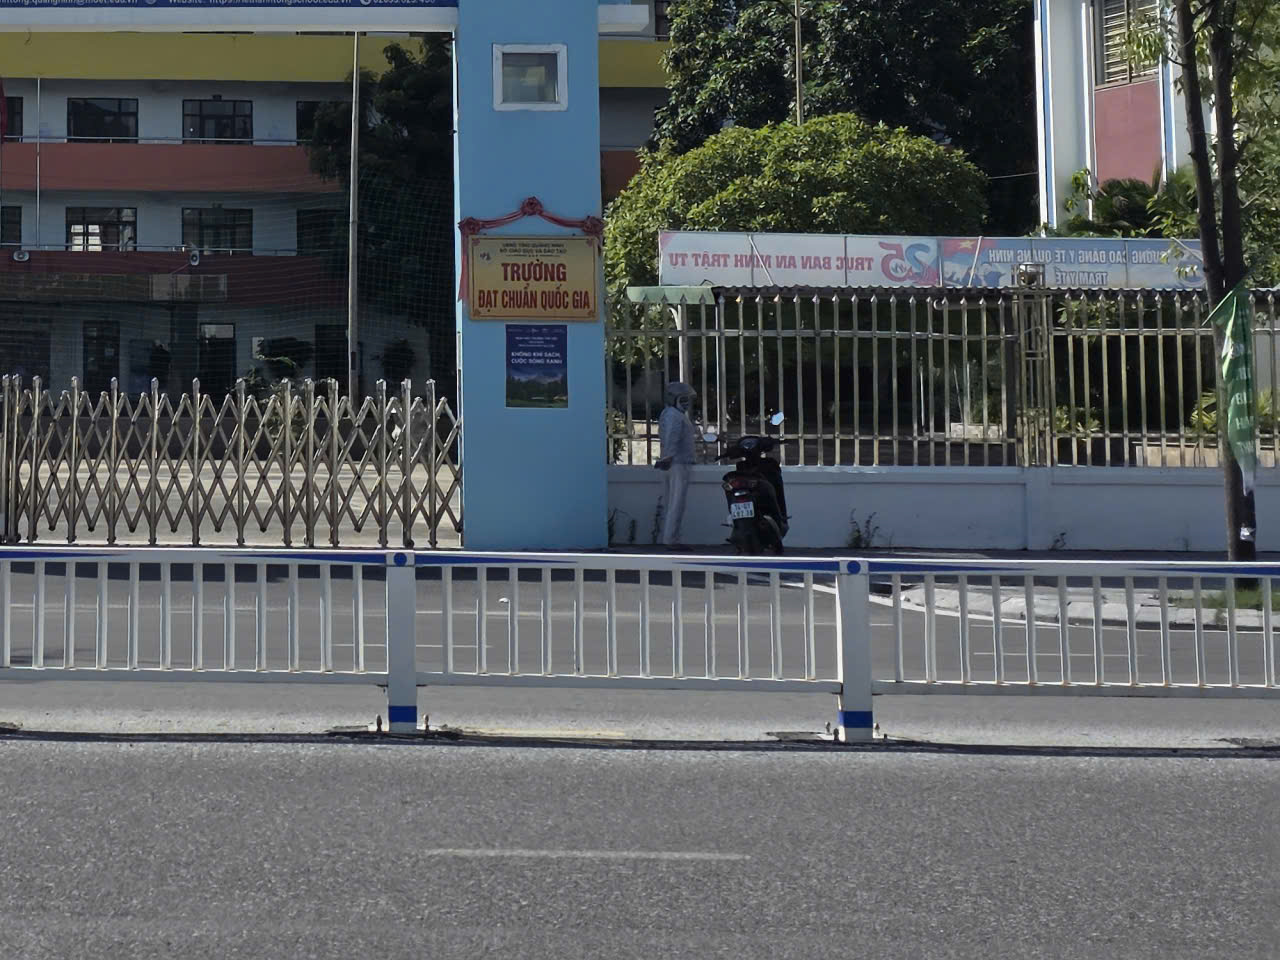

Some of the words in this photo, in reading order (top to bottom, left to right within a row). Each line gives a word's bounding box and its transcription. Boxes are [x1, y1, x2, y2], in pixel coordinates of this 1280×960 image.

[501, 259, 567, 282] TRƯỜNG
[478, 290, 499, 312] ĐẠT
[501, 283, 537, 308] CHUẨN
[541, 283, 569, 311] QUỐC
[572, 290, 590, 309] GIA
